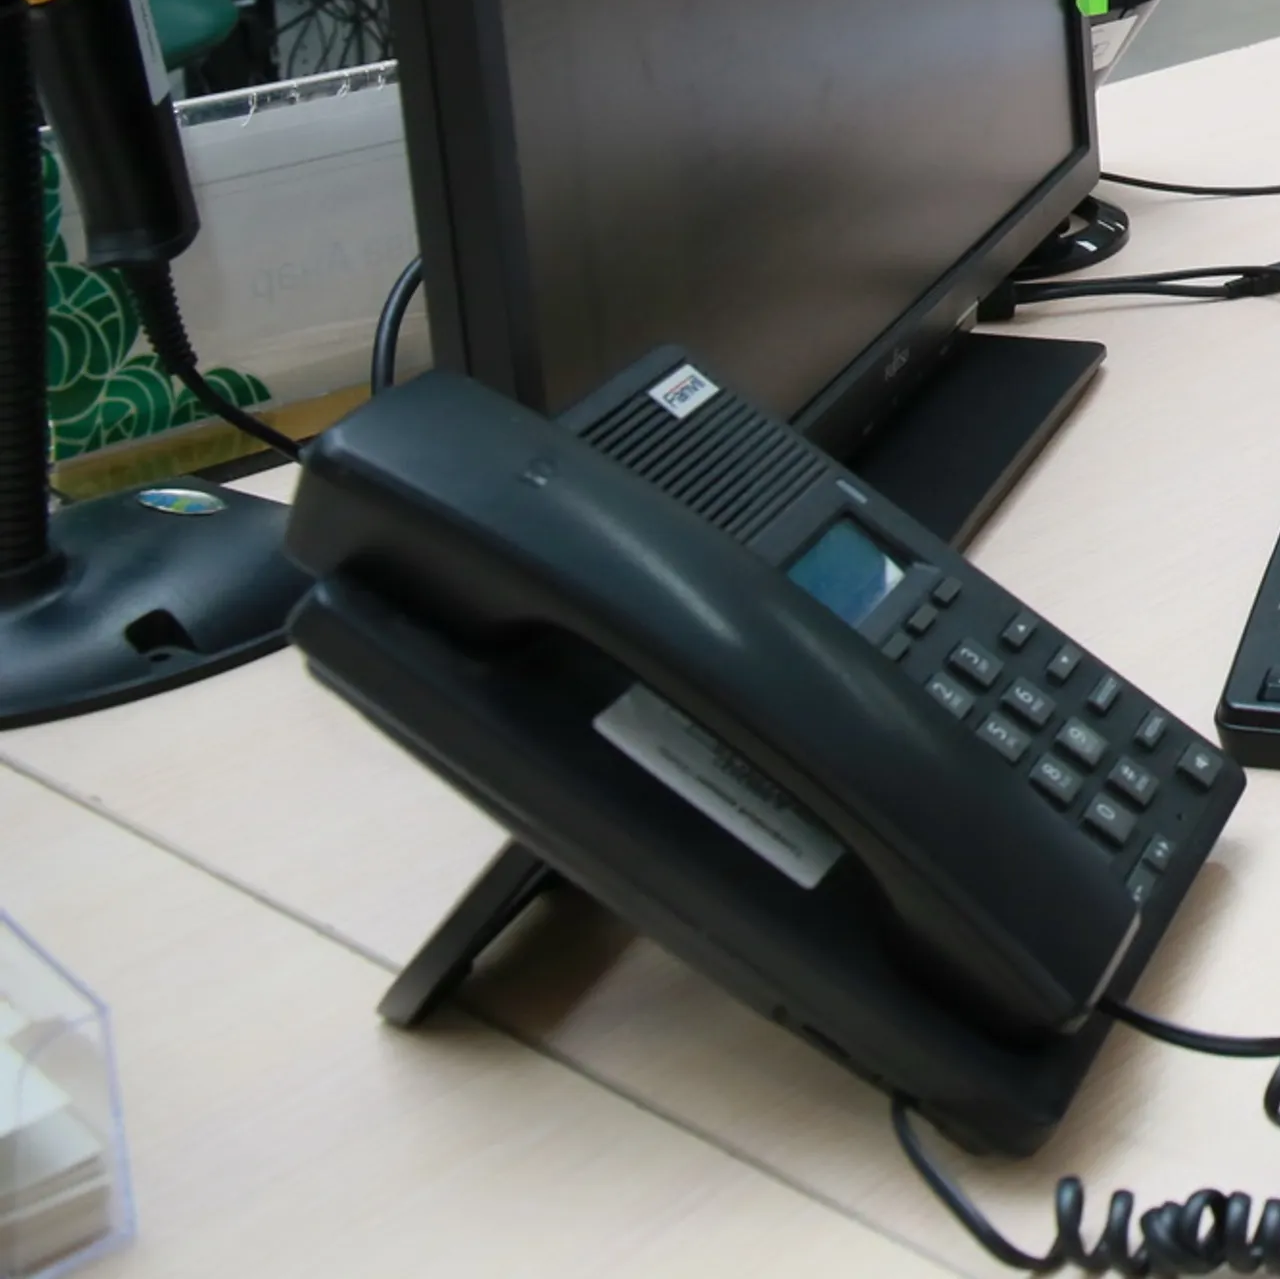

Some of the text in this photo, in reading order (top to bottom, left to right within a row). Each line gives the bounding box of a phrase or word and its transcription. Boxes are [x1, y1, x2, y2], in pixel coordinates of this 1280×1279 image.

[662, 374, 706, 409] Fanvil
[932, 647, 980, 702] 2 3
[986, 685, 1035, 741] 5 6
[1042, 726, 1088, 783] 8 9
[1096, 802, 1116, 823] 0
